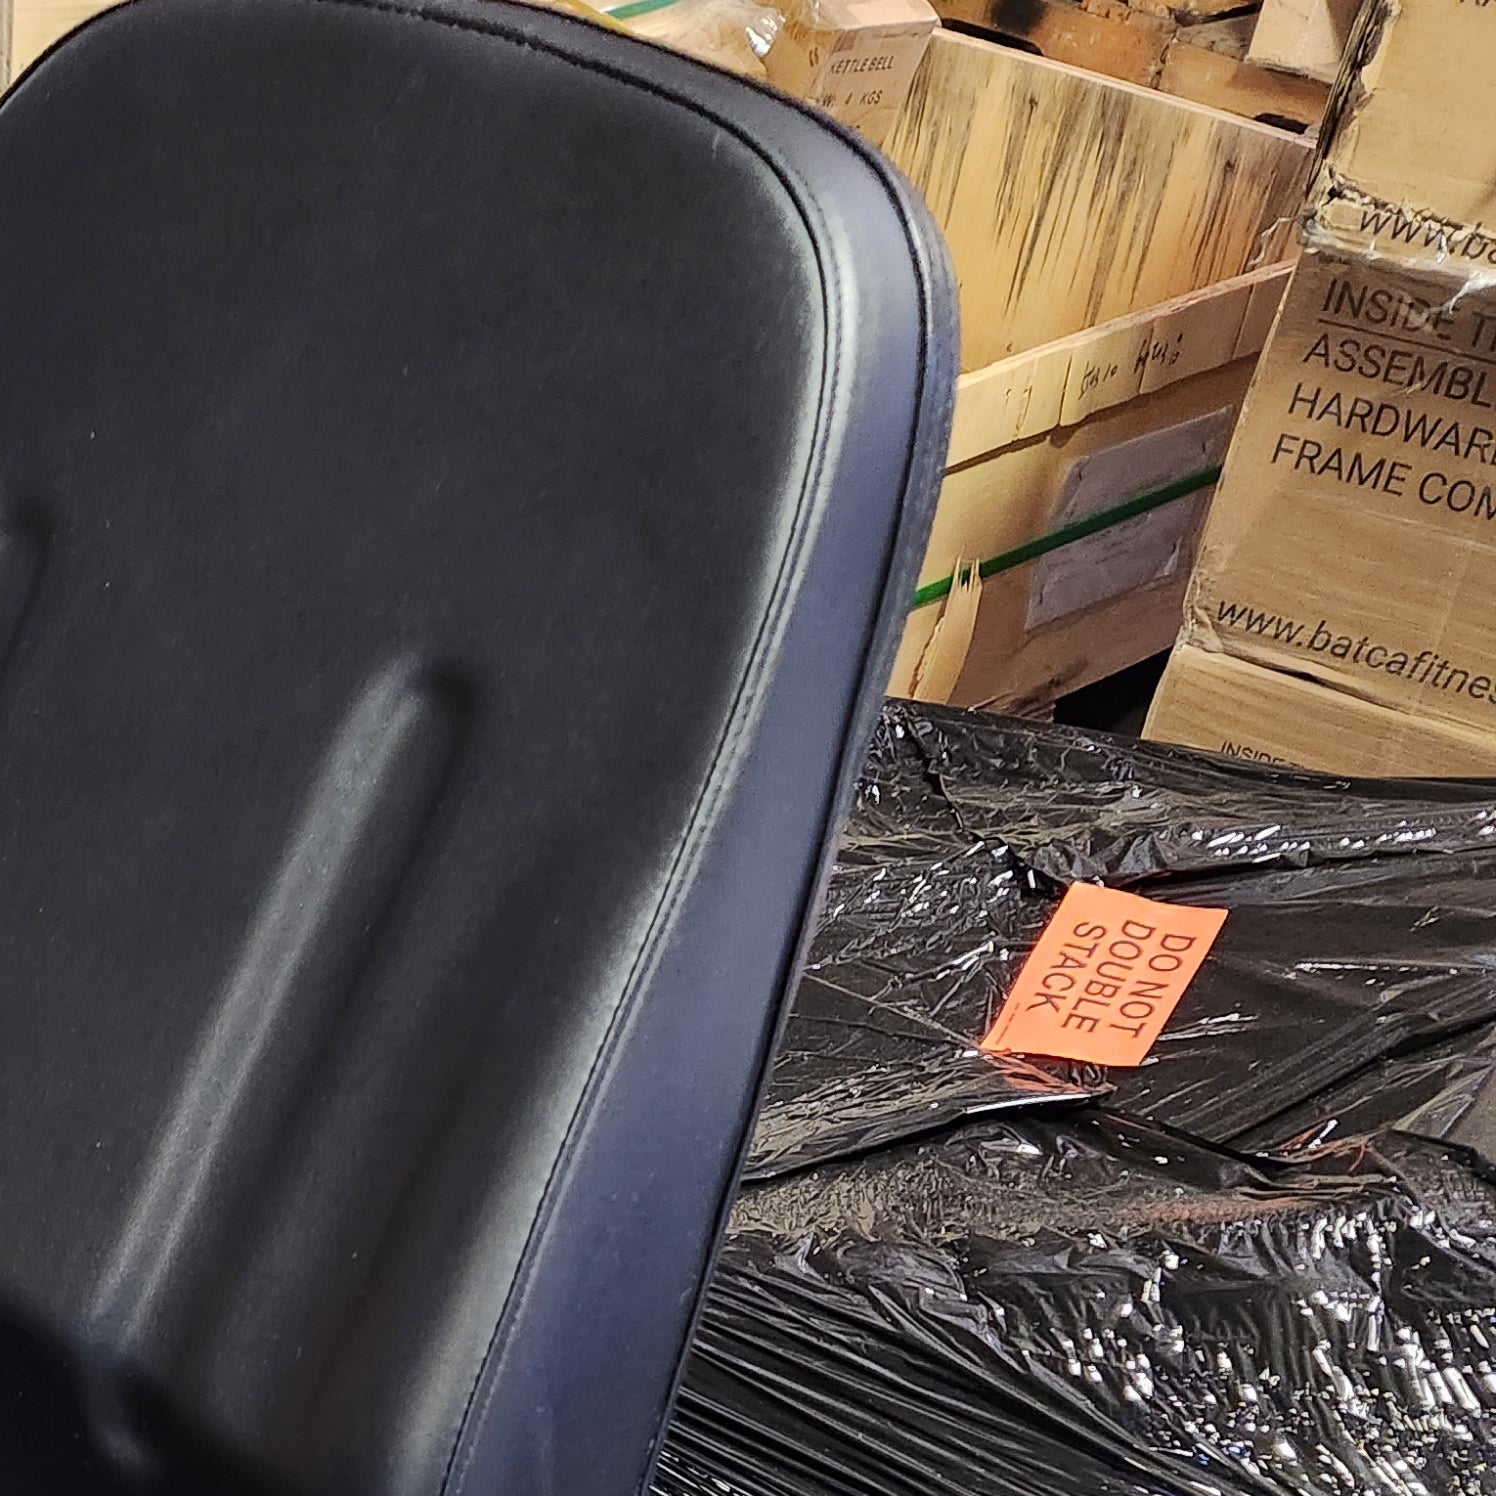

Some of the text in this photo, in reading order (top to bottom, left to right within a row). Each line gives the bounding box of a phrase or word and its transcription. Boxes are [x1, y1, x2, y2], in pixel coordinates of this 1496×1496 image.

[1320, 278, 1496, 352] INSIDE T
[1270, 433, 1413, 497] FRAME
[1287, 382, 1496, 466] HARDWAR
[1025, 921, 1107, 1014] STACK
[1062, 919, 1156, 1034] DOUBLE
[1109, 932, 1197, 1039] DO NOT
